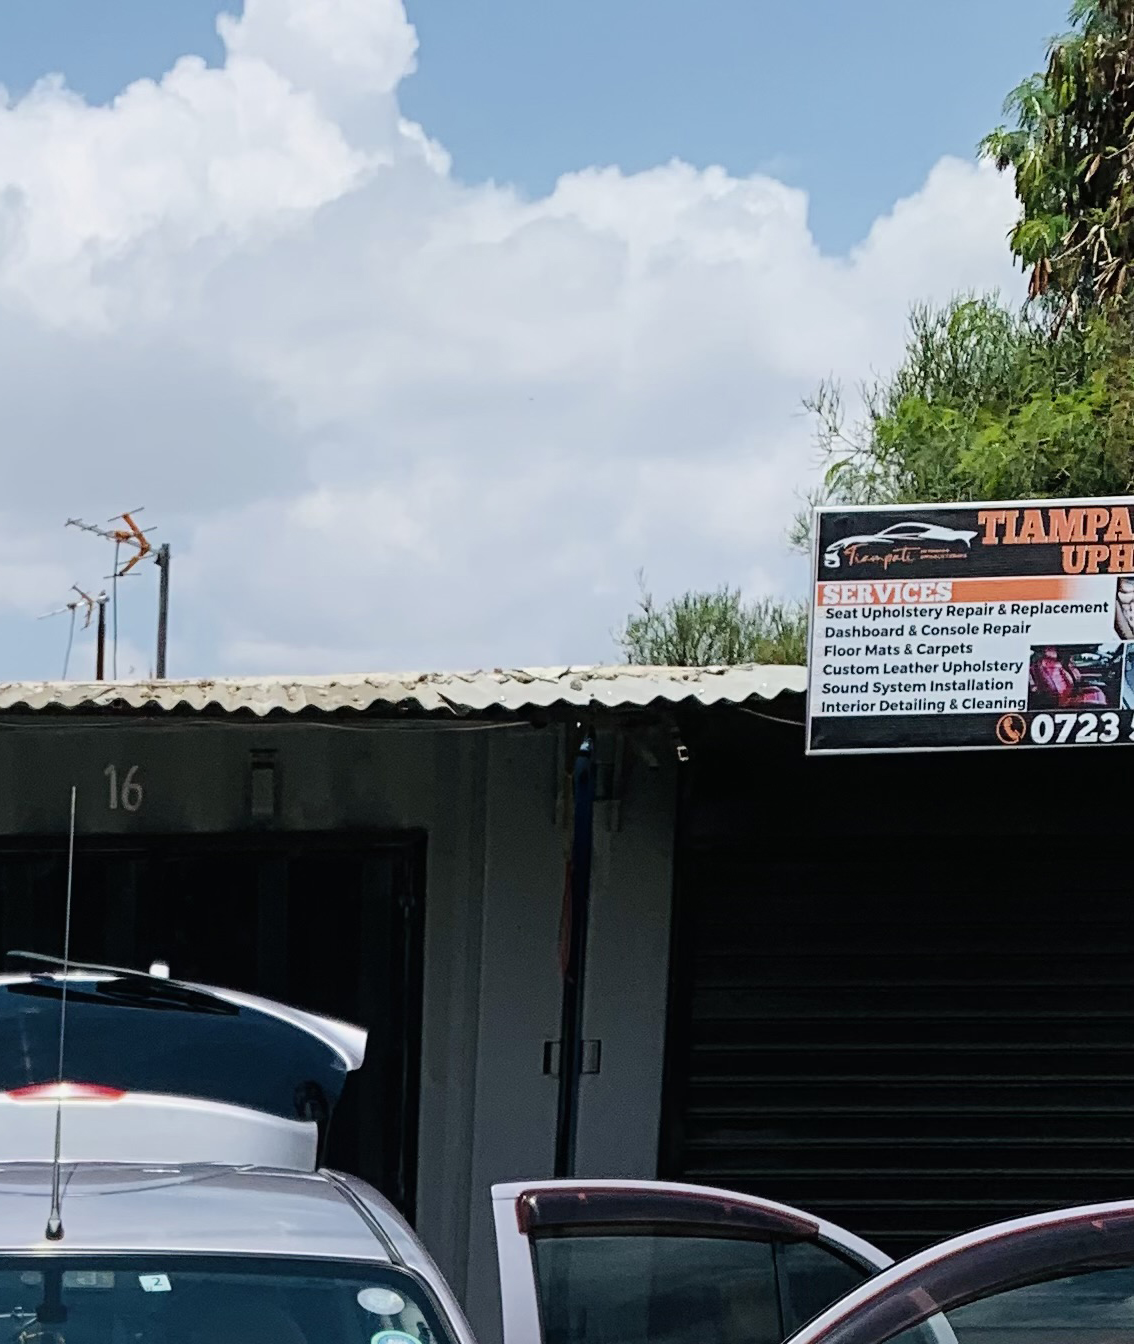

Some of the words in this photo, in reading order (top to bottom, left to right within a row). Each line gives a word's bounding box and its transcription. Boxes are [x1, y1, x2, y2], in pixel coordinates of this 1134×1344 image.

[822, 581, 952, 604] SERVICES
[826, 607, 858, 619] Seat
[862, 606, 943, 621] Upholstery
[947, 603, 994, 618] Repair
[998, 604, 1007, 615] &
[1011, 602, 1109, 617] Replacement
[825, 625, 905, 638] Dashboard
[908, 625, 917, 636] &
[921, 623, 979, 636] Console
[983, 621, 1031, 636] Repair
[824, 645, 861, 657] Floor
[865, 644, 900, 656] Mats
[904, 644, 913, 655] &
[916, 642, 973, 657] Carpets
[823, 664, 879, 675] Custom
[883, 662, 939, 674] Leather
[942, 660, 1023, 675] Upholstery
[822, 682, 869, 694] Sound
[872, 681, 926, 696] System
[930, 678, 1014, 692] Installation
[821, 700, 876, 712] Interior
[879, 698, 945, 712] Detailing
[949, 698, 958, 710] &
[962, 696, 1026, 711] Cleaning
[1030, 711, 1120, 744] 0723
[104, 764, 143, 811] 16
